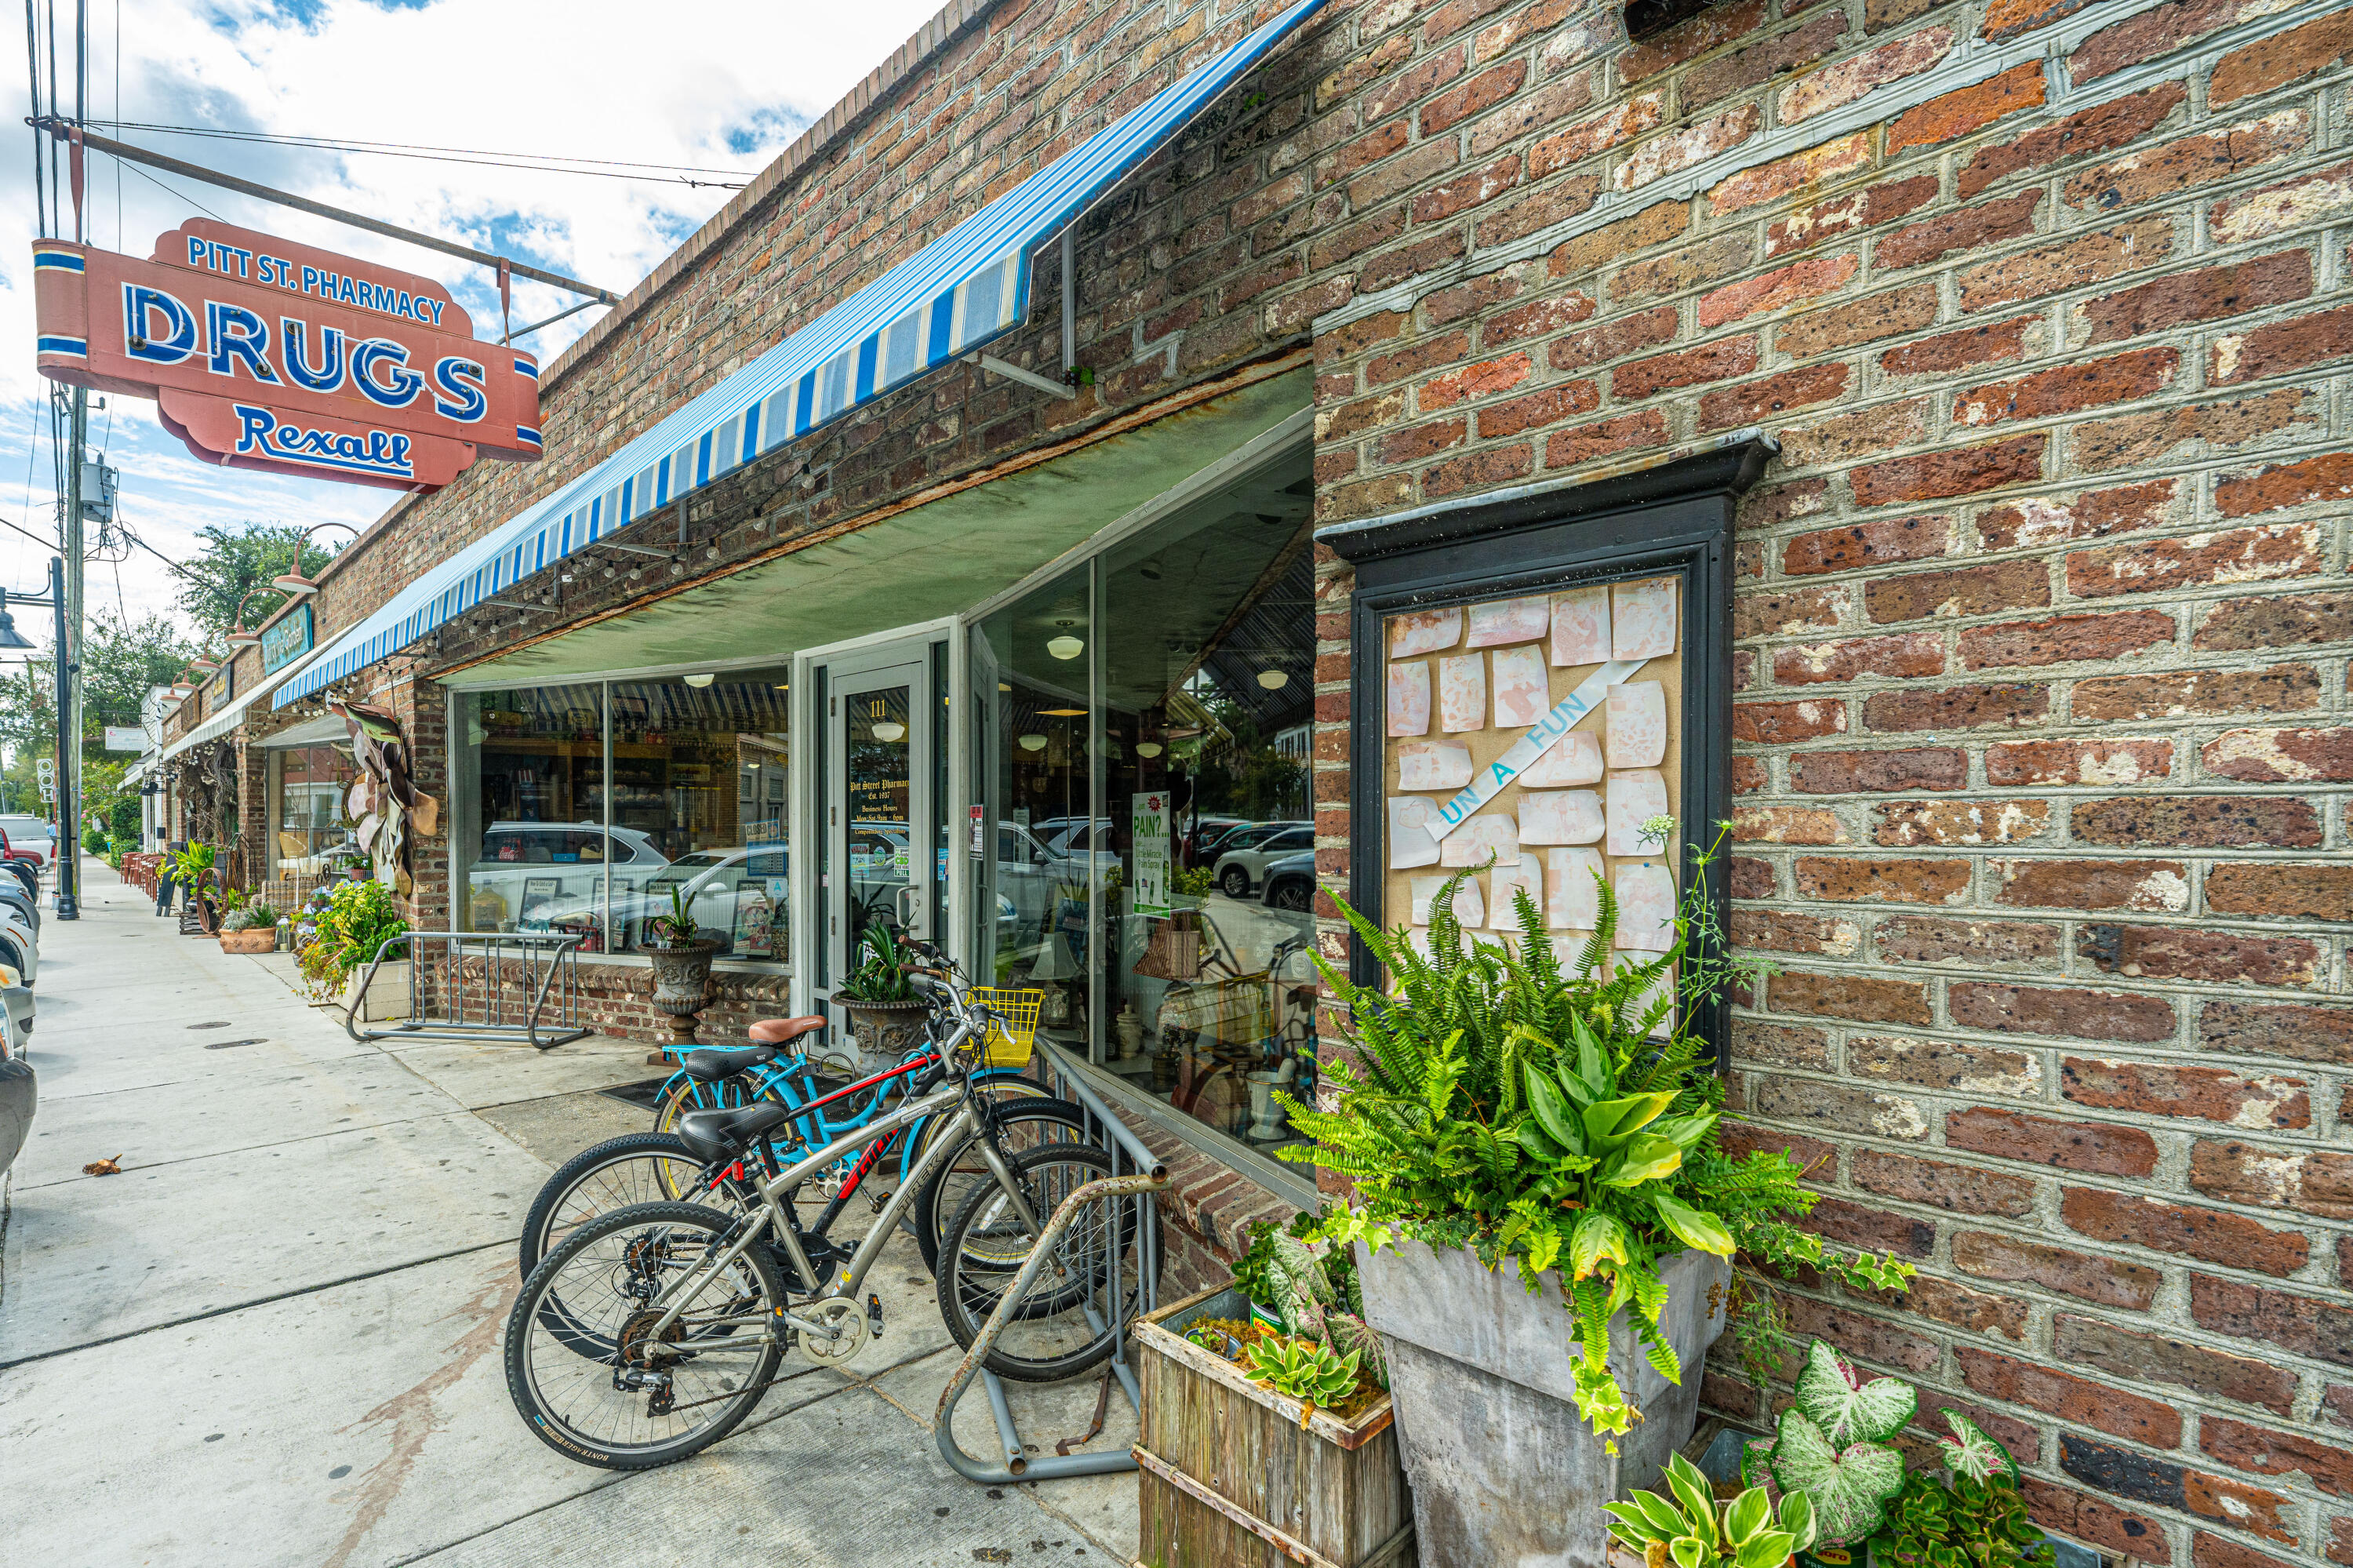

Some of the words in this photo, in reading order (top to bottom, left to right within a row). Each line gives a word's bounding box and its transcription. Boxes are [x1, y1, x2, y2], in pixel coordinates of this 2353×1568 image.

[187, 235, 253, 278] PITT
[256, 255, 297, 291] ST.
[302, 265, 446, 326] PHARMACY
[121, 282, 488, 424] DRUGS
[234, 403, 415, 478] Rexall
[870, 699, 886, 718] 111
[1439, 787, 1480, 824] UN
[1490, 762, 1515, 785] A
[1526, 693, 1588, 748] FUN
[850, 781, 861, 793] Pitt
[862, 780, 880, 790] Street
[893, 813, 904, 822] 6pm
[747, 823, 767, 835] CLOSED
[896, 857, 909, 865] CBD
[773, 882, 782, 891] A
[904, 1108, 928, 1122] NAVIGATOR
[897, 1153, 942, 1213] TREK
[562, 1440, 609, 1461] BONTRAGER
